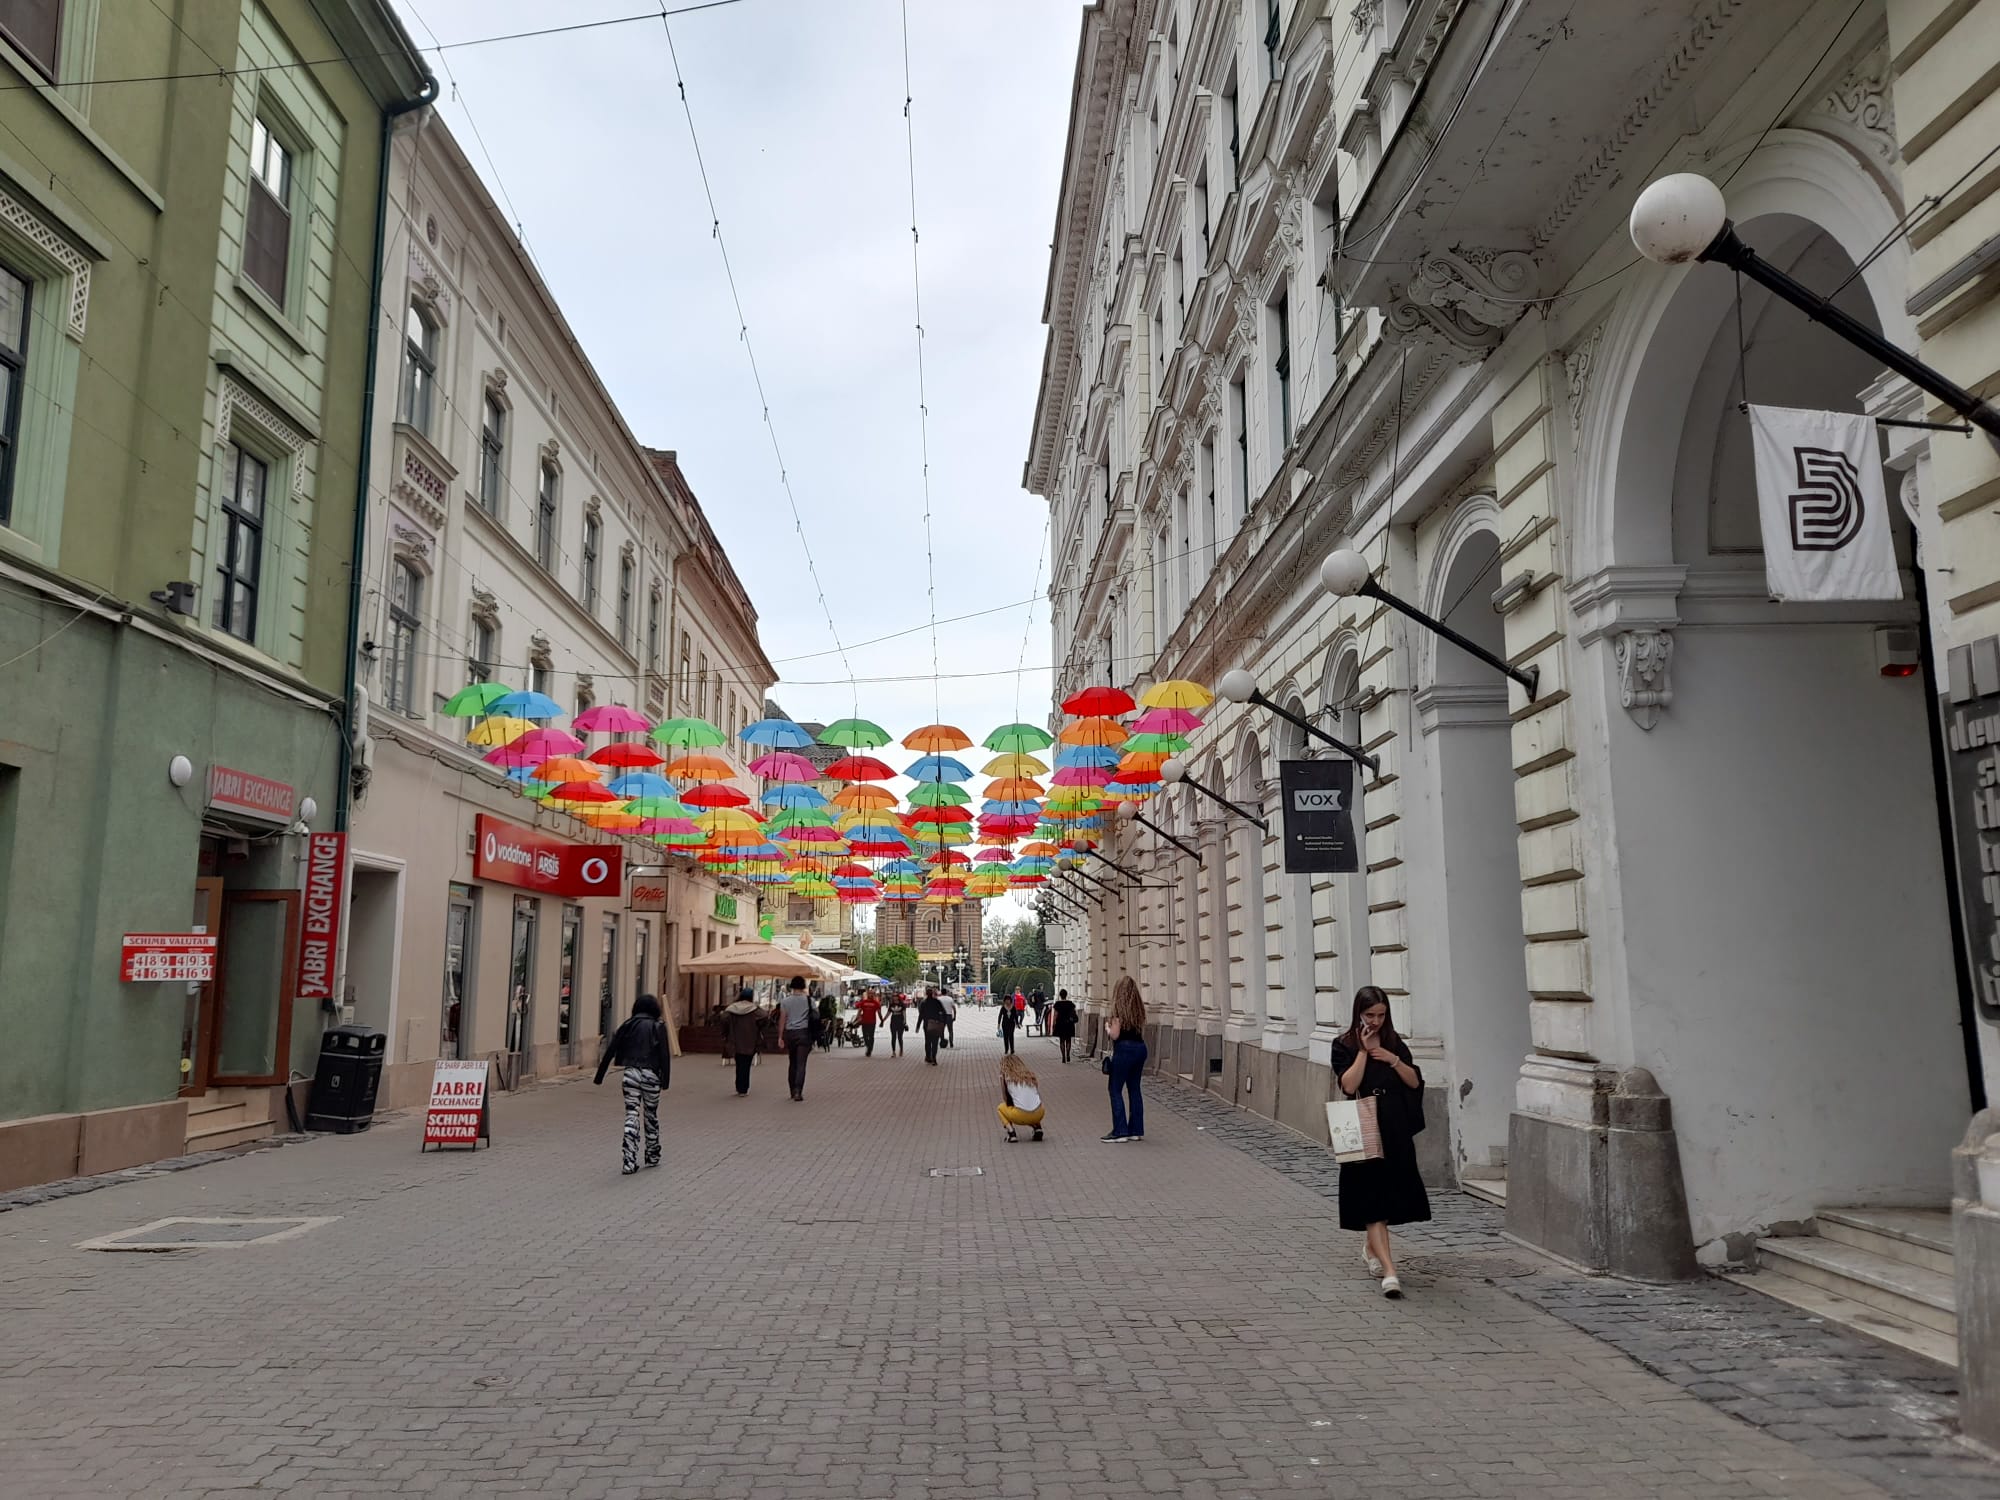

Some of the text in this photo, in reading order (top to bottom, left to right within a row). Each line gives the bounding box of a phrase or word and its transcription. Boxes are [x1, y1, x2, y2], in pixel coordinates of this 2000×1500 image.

[213, 771, 292, 812] JABRI EXCHANGE
[1298, 794, 1333, 806] VOX
[497, 843, 532, 867] vodafone
[301, 836, 337, 996] JABRI EXCHANGE
[129, 937, 209, 945] SCHIMB VALUTAR
[433, 1081, 483, 1096] JABRI
[431, 1097, 481, 1106] EXCHANGE
[428, 1113, 478, 1126] SCHIMB
[426, 1126, 475, 1138] VALUTAR
